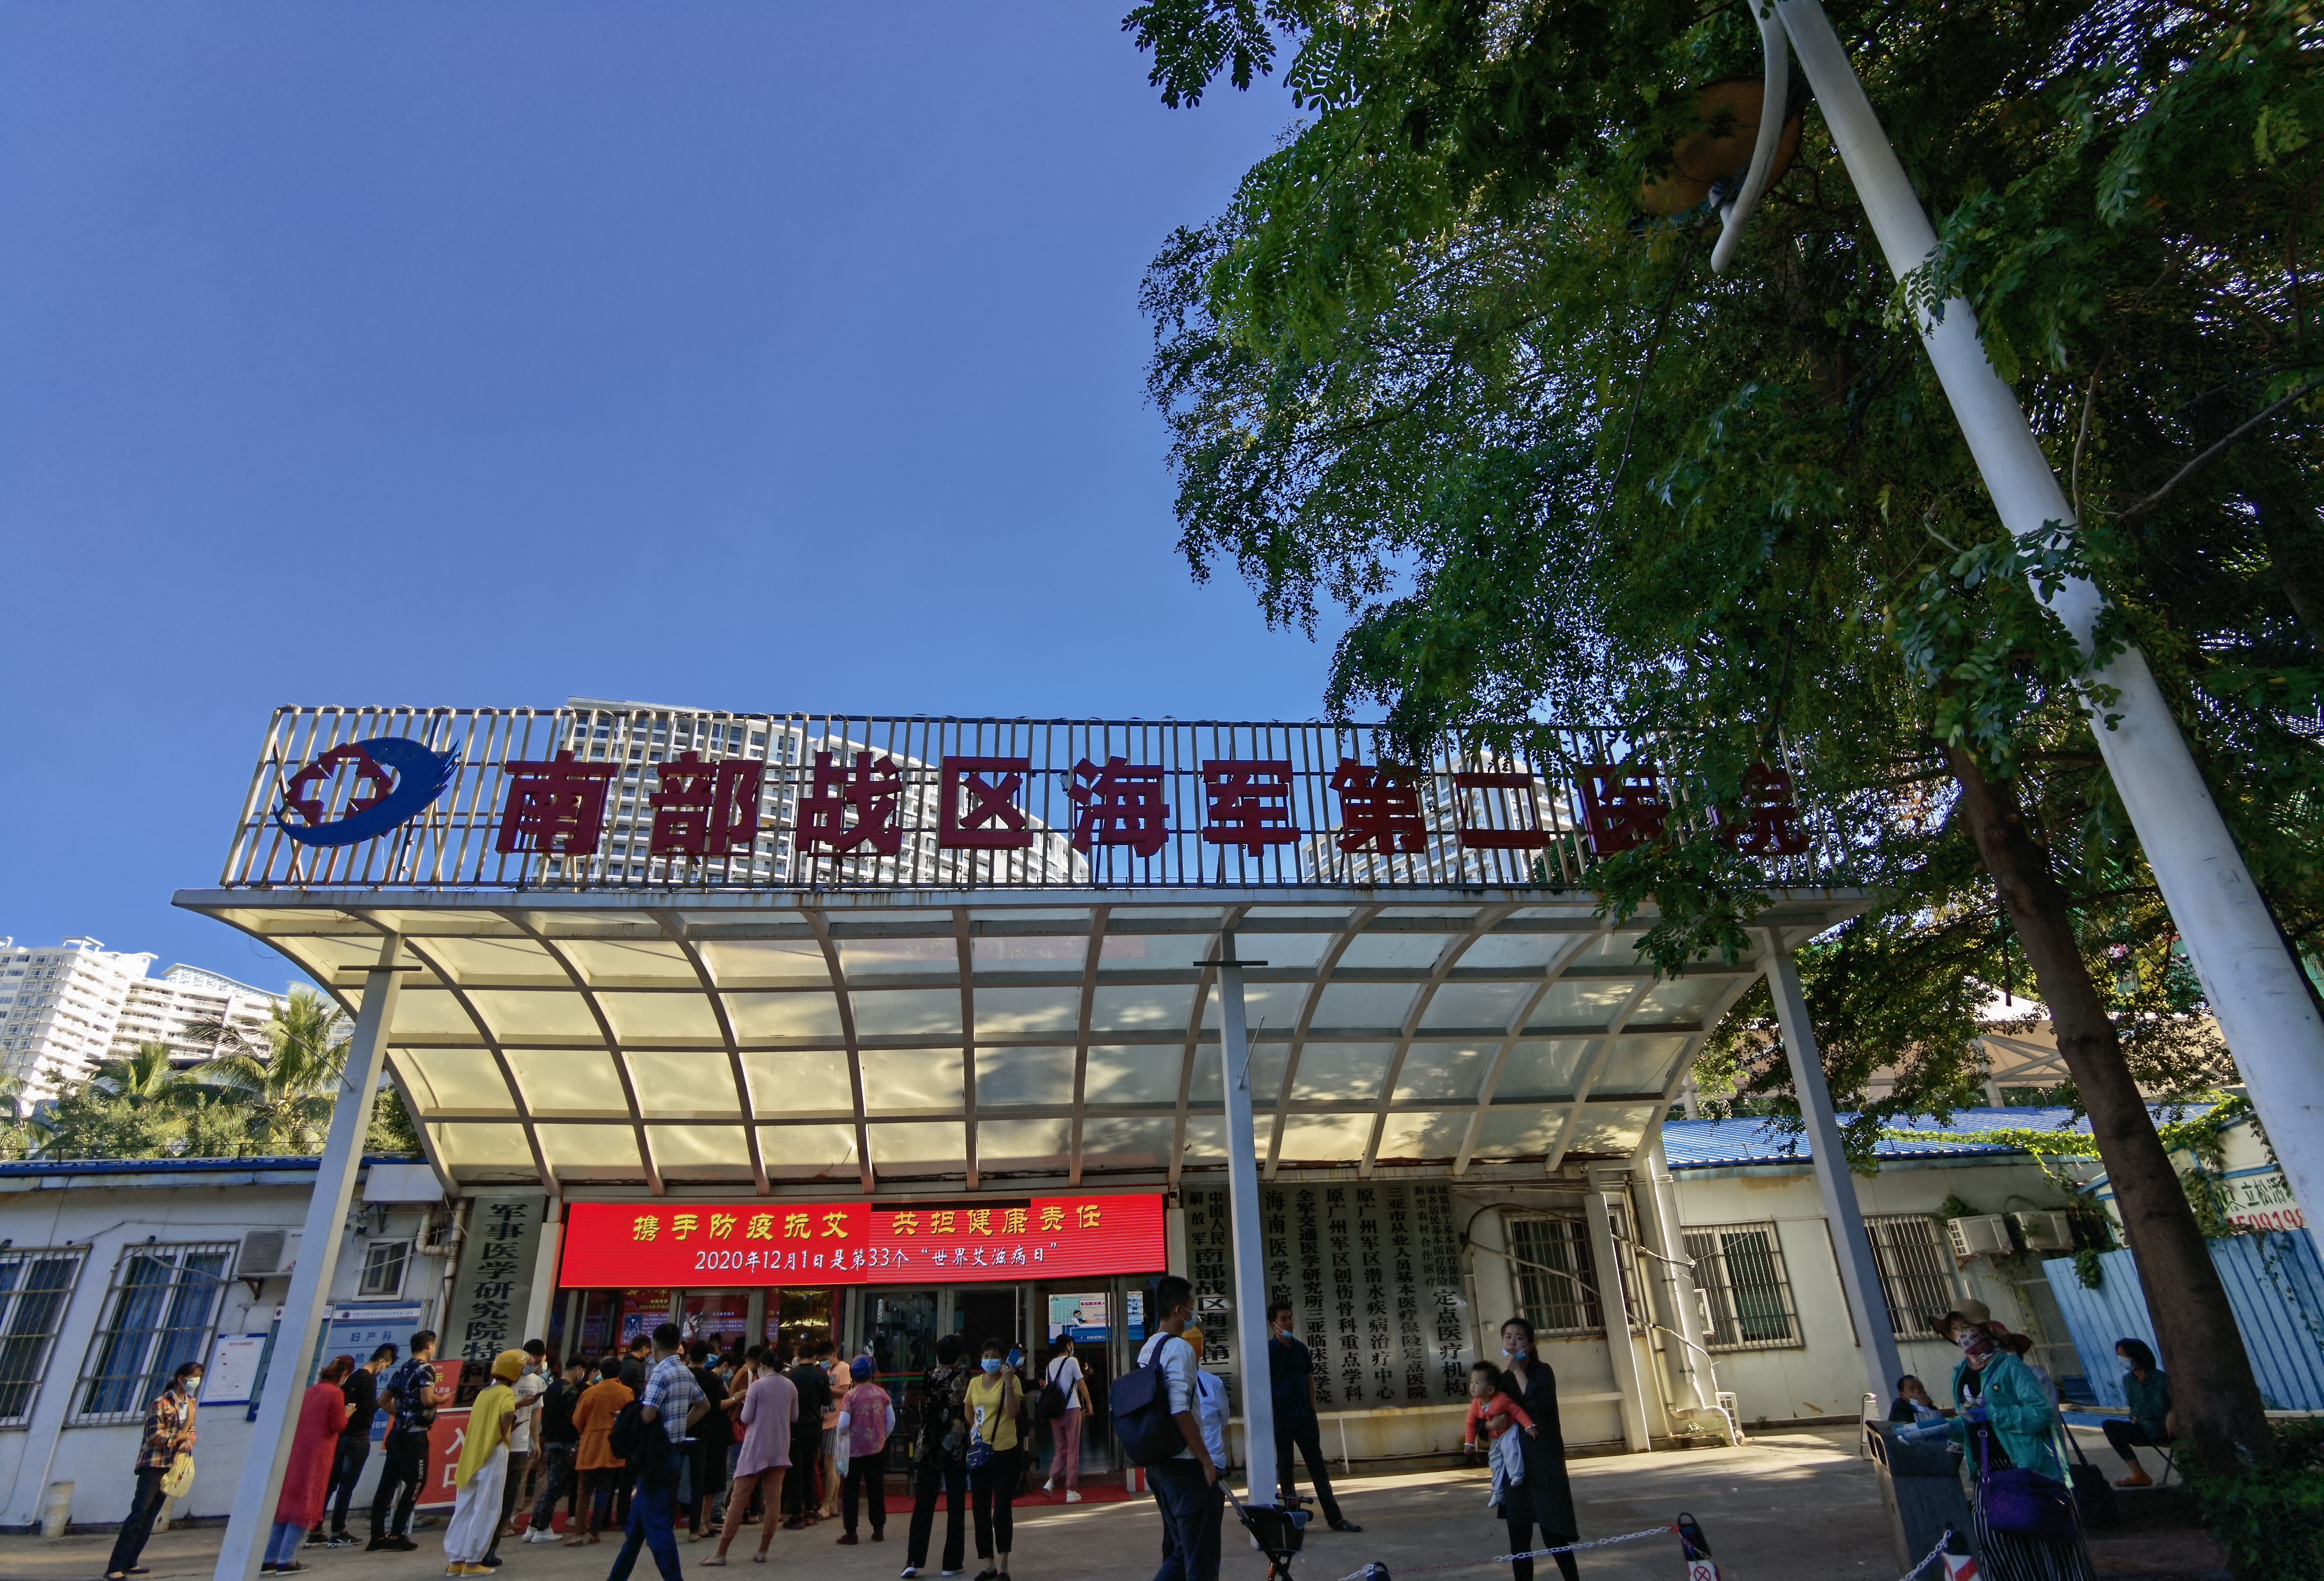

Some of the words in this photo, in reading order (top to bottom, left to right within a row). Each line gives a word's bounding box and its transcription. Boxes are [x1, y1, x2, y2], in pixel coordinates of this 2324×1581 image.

[495, 750, 1810, 859] 南部战区海军第二医院
[633, 1211, 849, 1242] 携手防疫抗艾
[892, 1204, 1102, 1236] 共担健康责任
[1189, 1191, 1206, 1245] 解放军
[1209, 1191, 1225, 1245] 中国人民
[1414, 1186, 1435, 1287] 新型农村合作医疗
[1425, 1186, 1448, 1287] 城乡居民基本医疗保险
[1438, 1185, 1460, 1286] 城镇职工基本医疗保险
[350, 1331, 391, 1342] 妇产科
[1194, 1248, 1232, 1399] 南部战区海军第二
[1296, 1189, 1332, 1404] 全军交通医学研究所三亚临床医学院
[1326, 1188, 1364, 1401] 原广州军区创伤骨科重点学科
[1357, 1187, 1395, 1400] 原广州军区潜水疾病治疗中心
[1385, 1187, 1428, 1399] 三亚市从业人员基本医疗保险定点医院
[1433, 1289, 1468, 1397] 定点医疗机构
